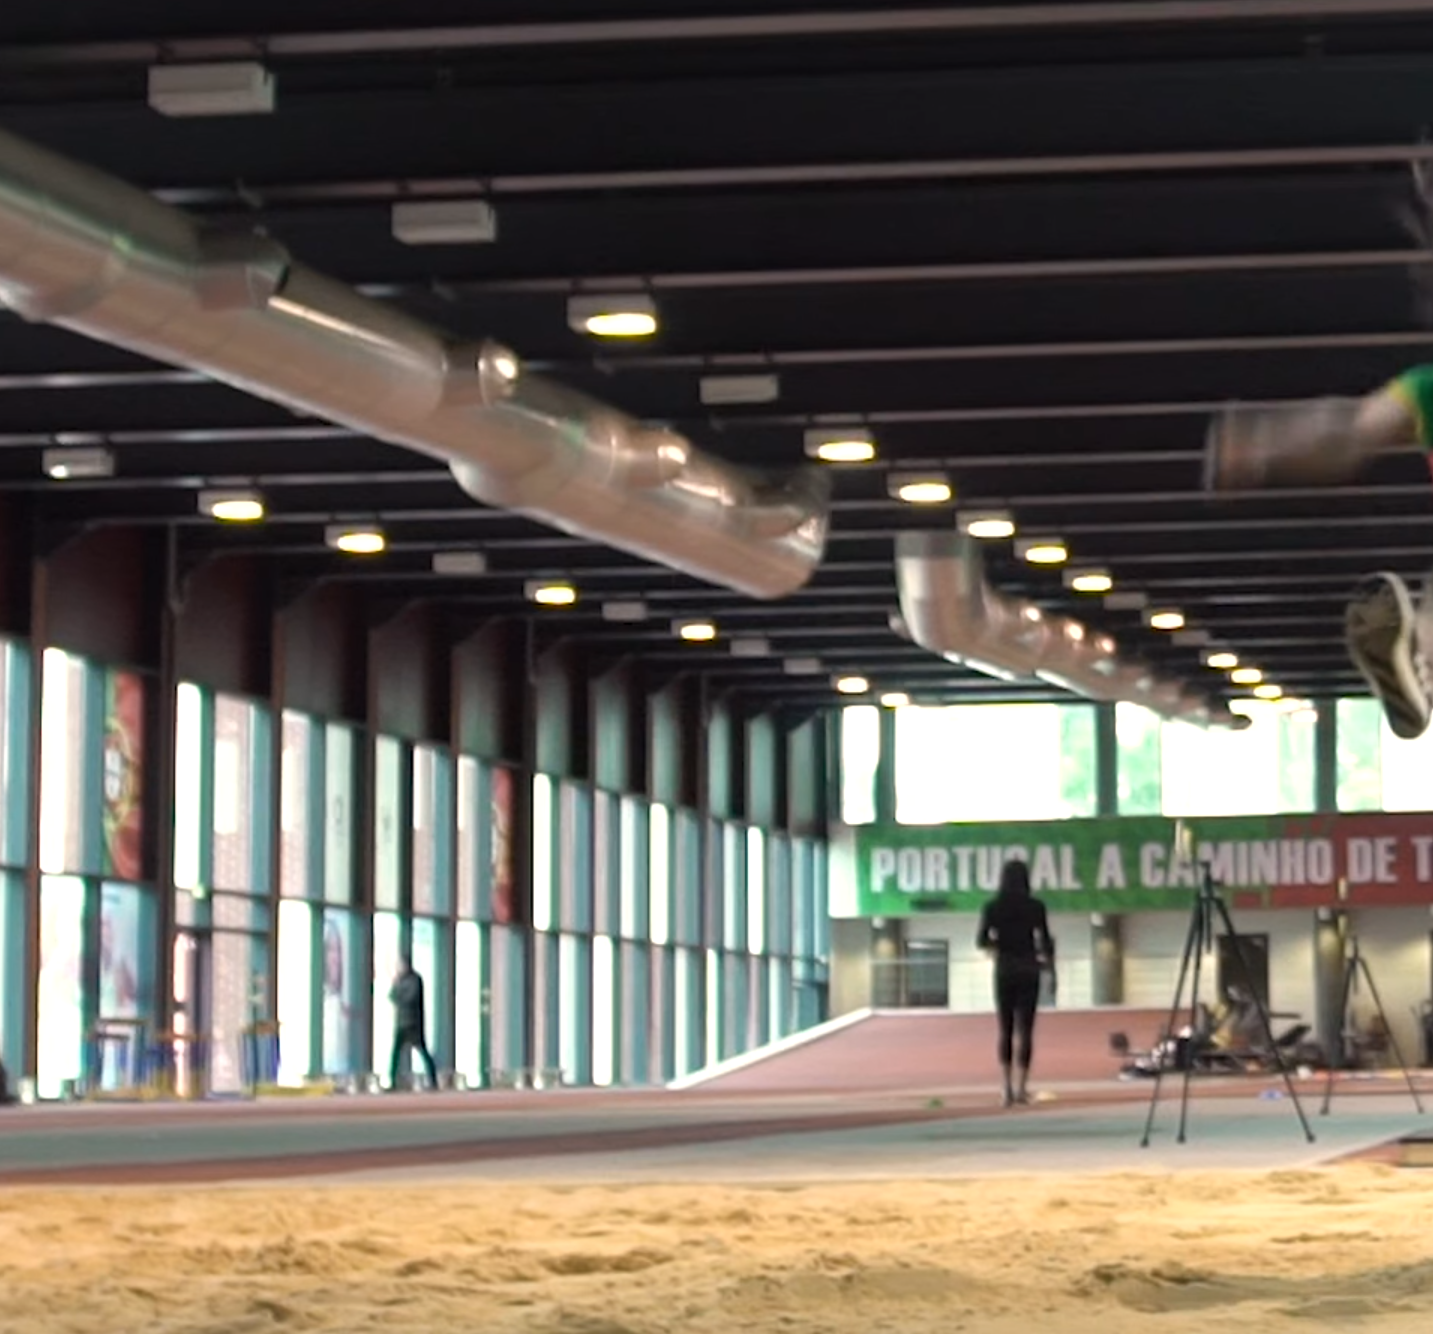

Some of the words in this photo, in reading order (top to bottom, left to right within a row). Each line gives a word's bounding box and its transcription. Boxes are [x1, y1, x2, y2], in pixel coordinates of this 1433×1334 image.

[1098, 842, 1127, 889] A
[1140, 838, 1333, 888] CAMINHO
[1346, 836, 1397, 884] DE
